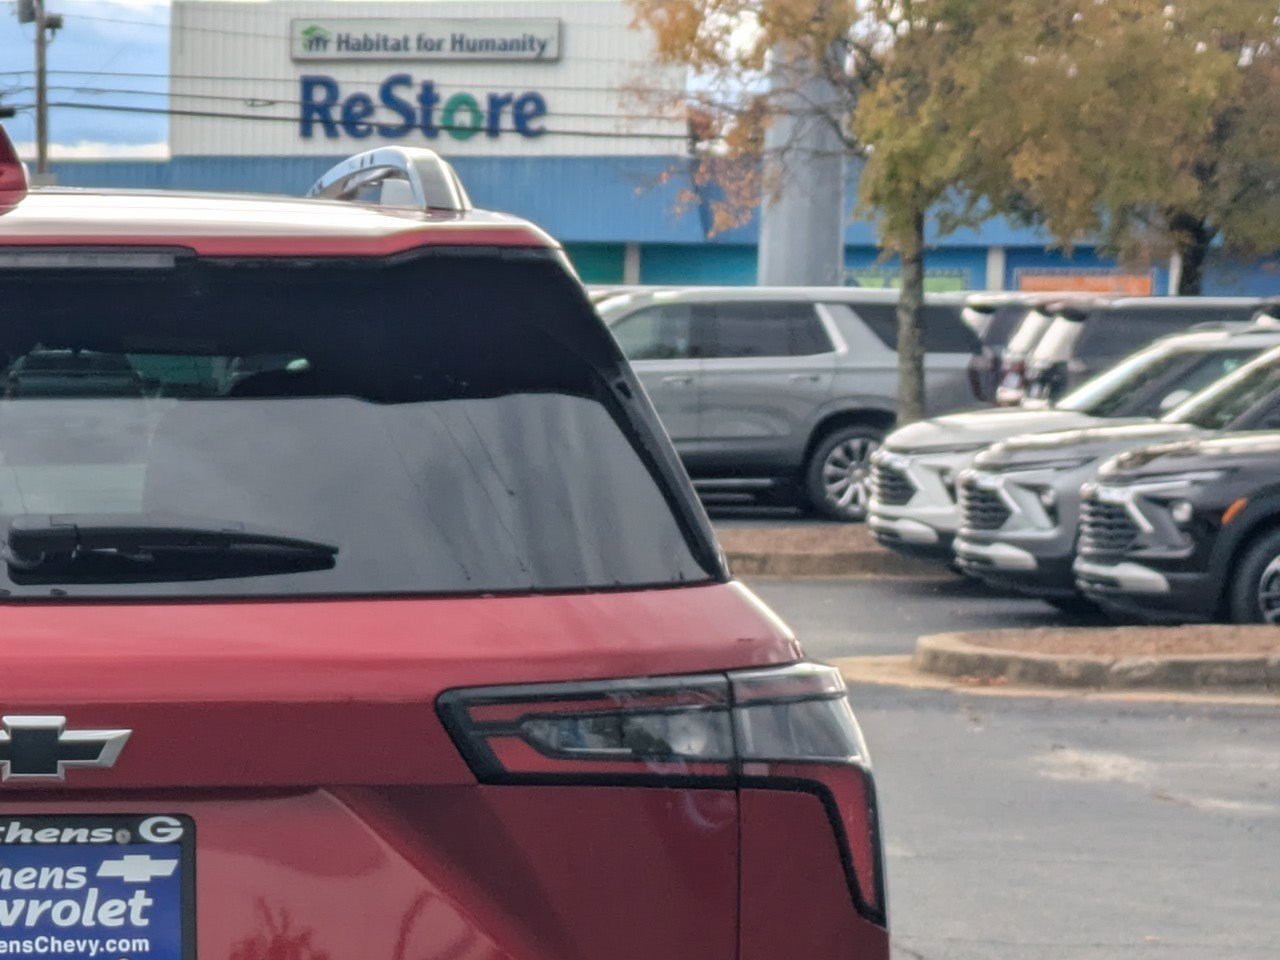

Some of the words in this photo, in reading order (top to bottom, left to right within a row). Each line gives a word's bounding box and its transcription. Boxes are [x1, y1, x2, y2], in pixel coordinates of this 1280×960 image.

[336, 33, 410, 52] Habitat
[417, 33, 444, 52] for
[450, 33, 548, 59] Humanity
[299, 73, 548, 140] ReStore
[138, 816, 183, 843] G
